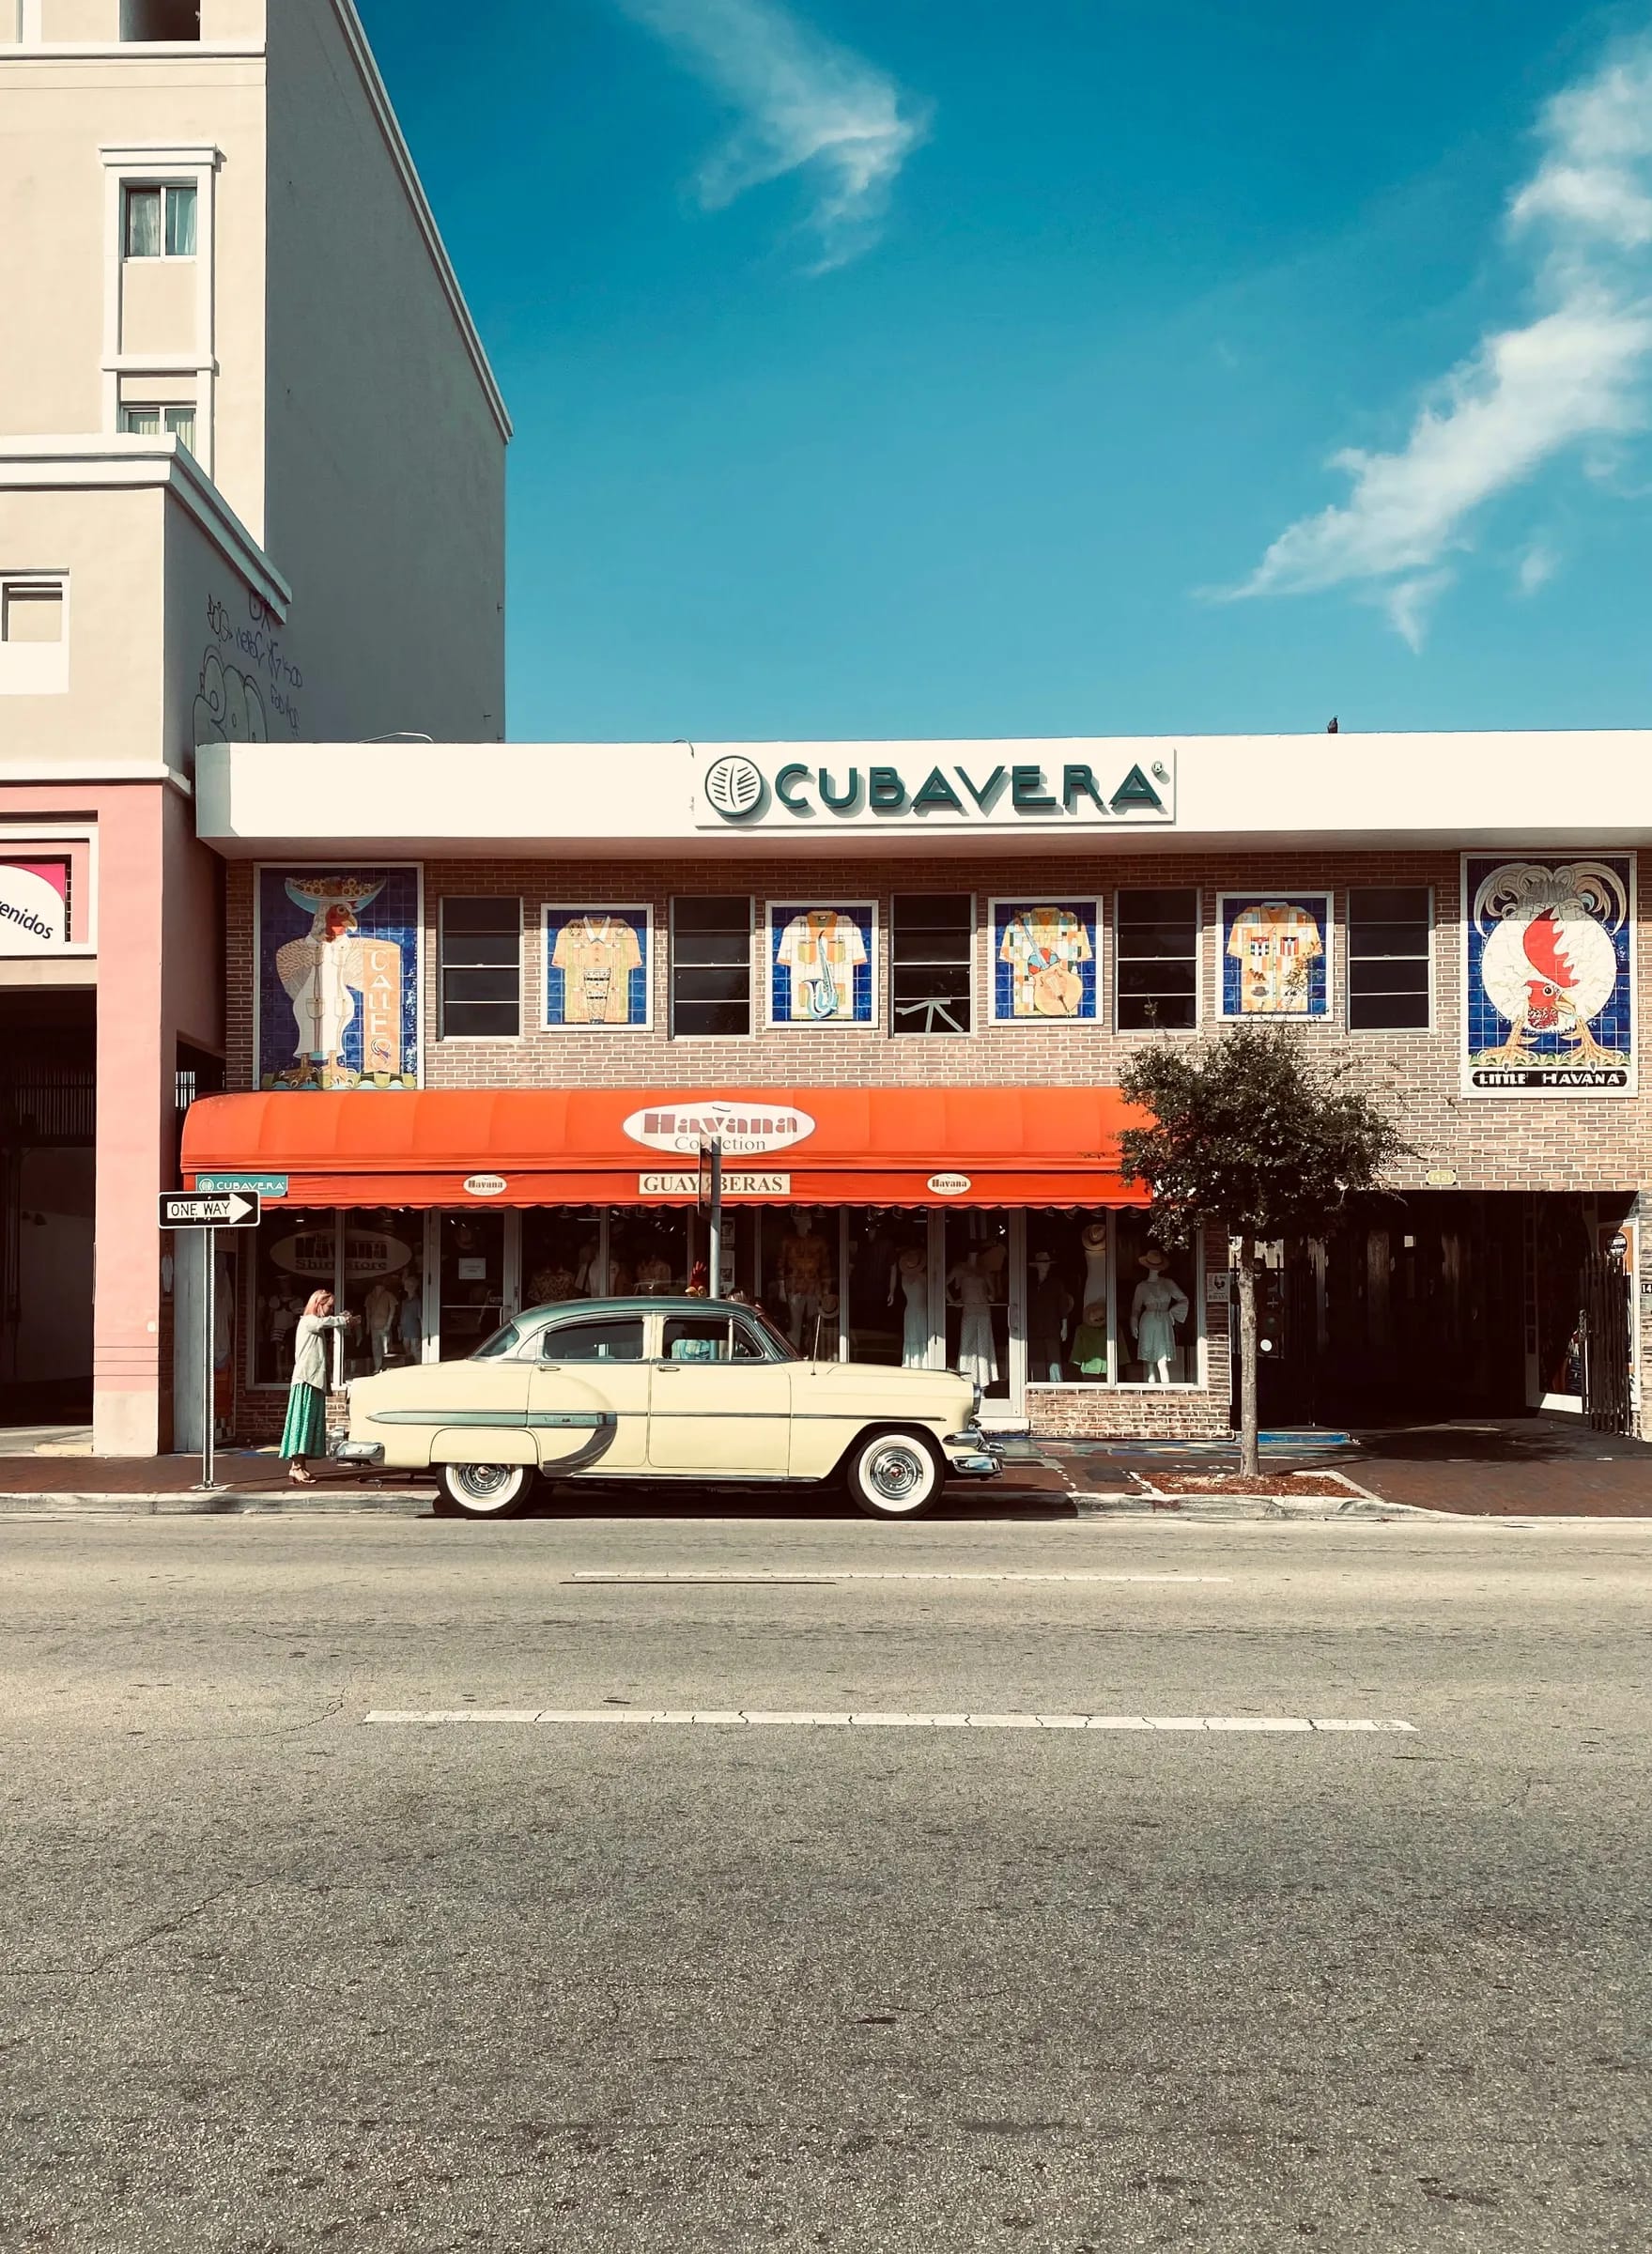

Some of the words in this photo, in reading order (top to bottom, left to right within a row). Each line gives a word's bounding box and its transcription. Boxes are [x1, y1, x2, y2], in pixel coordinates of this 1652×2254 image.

[0, 901, 54, 939] enidos
[1479, 1073, 1526, 1085] LITTLE
[1541, 1073, 1620, 1085] HAVANA
[643, 1113, 798, 1135] Havana
[674, 1135, 766, 1151] Coction
[216, 1181, 285, 1191] CUBAVERA
[468, 1180, 503, 1189] Havana
[643, 1176, 783, 1192] GUAYBERAS
[932, 1179, 967, 1188] Havana
[171, 1203, 197, 1217] ONE
[203, 1202, 230, 1216] WAY
[295, 1259, 336, 1271] Shir
